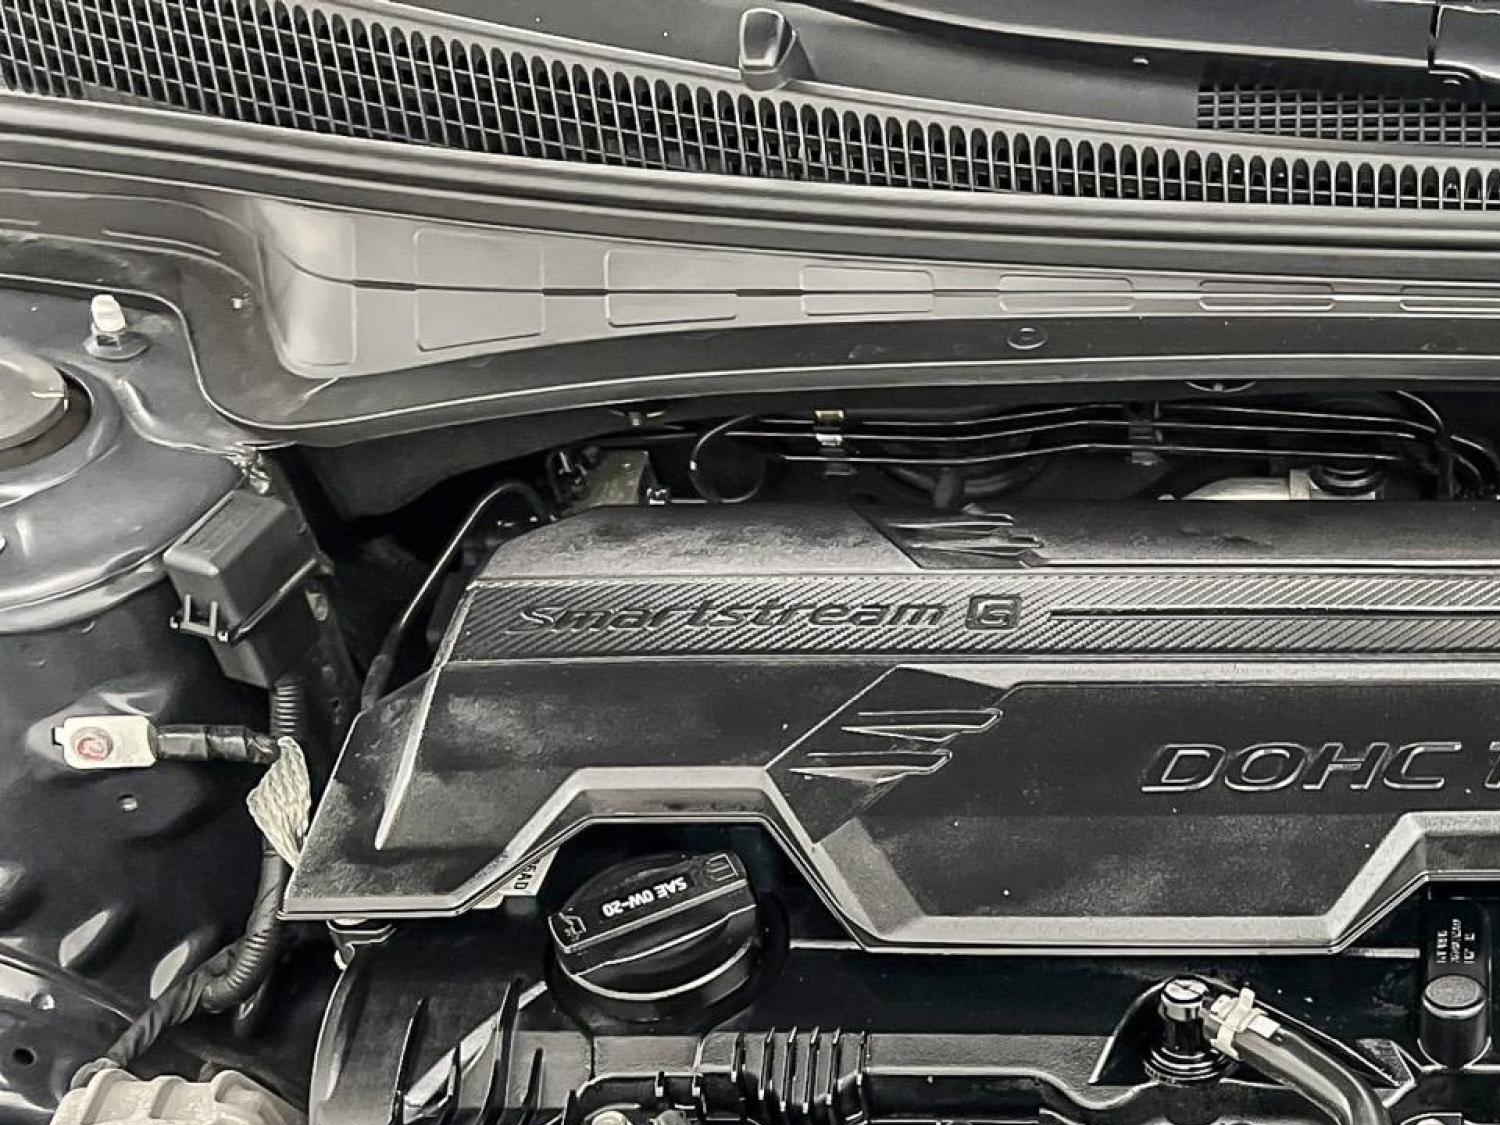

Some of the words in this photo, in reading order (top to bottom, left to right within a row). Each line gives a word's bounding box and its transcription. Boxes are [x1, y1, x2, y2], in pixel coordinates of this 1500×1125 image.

[503, 597, 947, 636] Smartstream
[1141, 741, 1462, 794] DOHC
[601, 888, 655, 918] 0W-20
[654, 876, 688, 900] SAE
